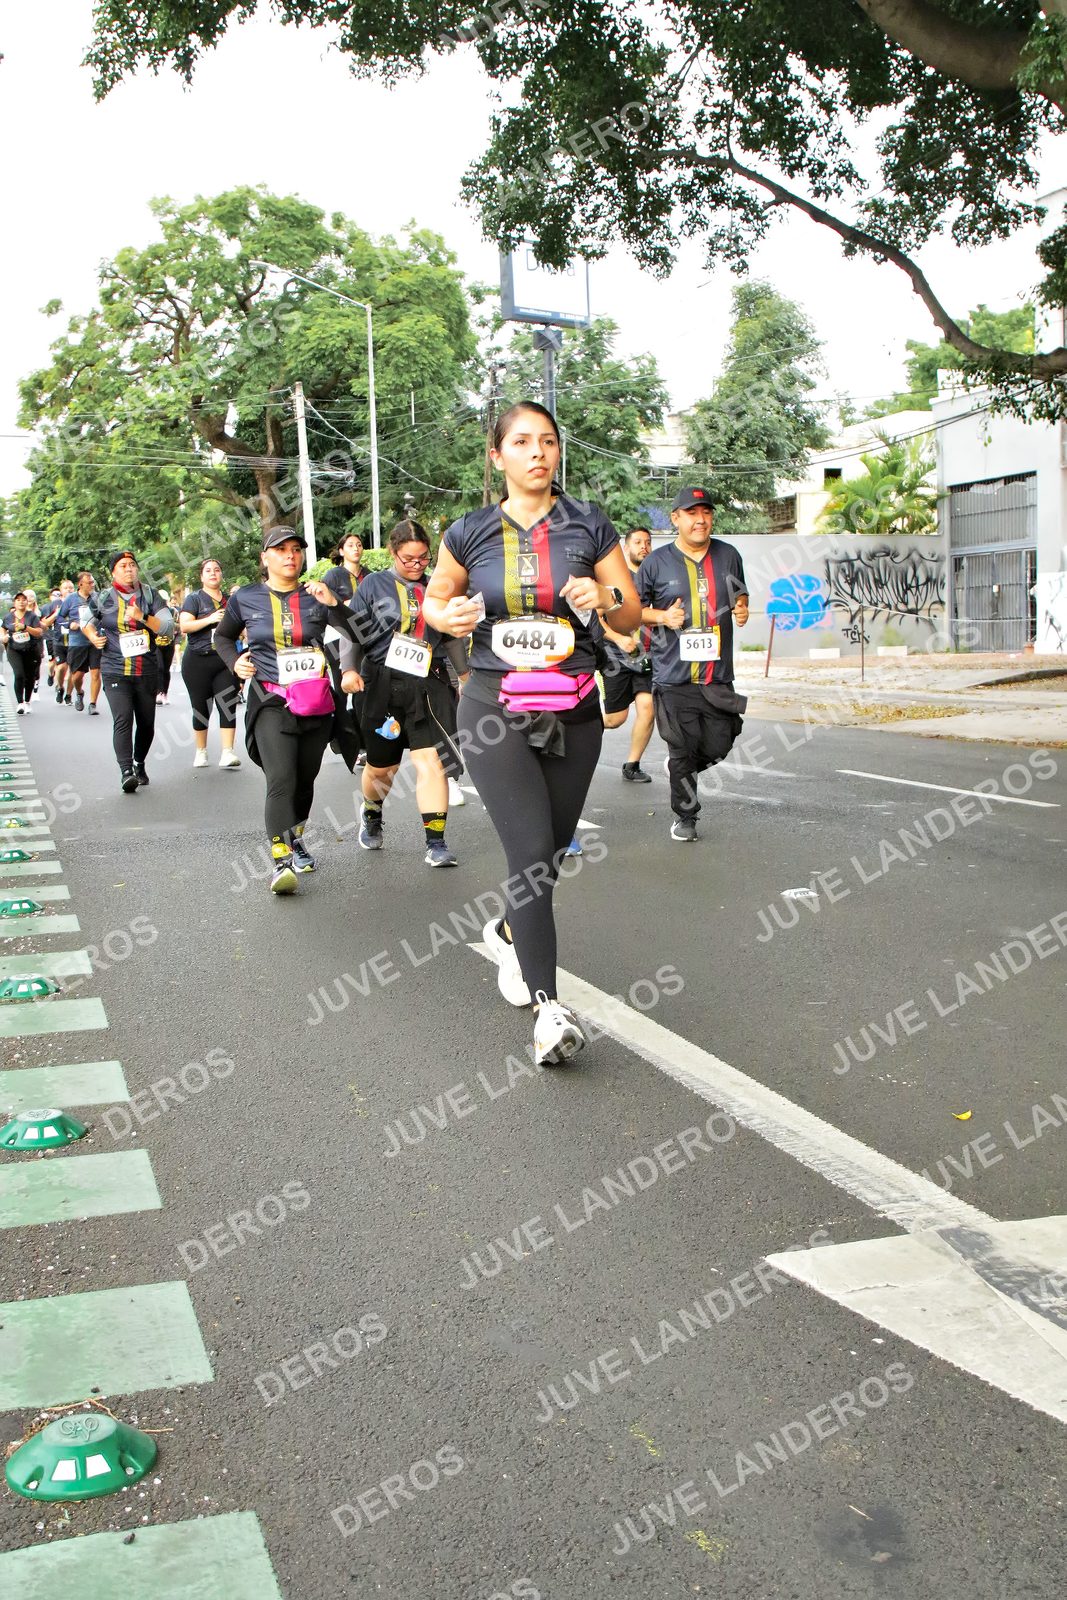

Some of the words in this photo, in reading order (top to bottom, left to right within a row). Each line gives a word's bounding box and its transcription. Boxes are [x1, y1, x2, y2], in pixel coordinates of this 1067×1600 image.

[502, 629, 557, 650] 6484
[686, 637, 713, 650] 5613
[394, 645, 424, 663] 6170
[285, 658, 315, 673] 6162
